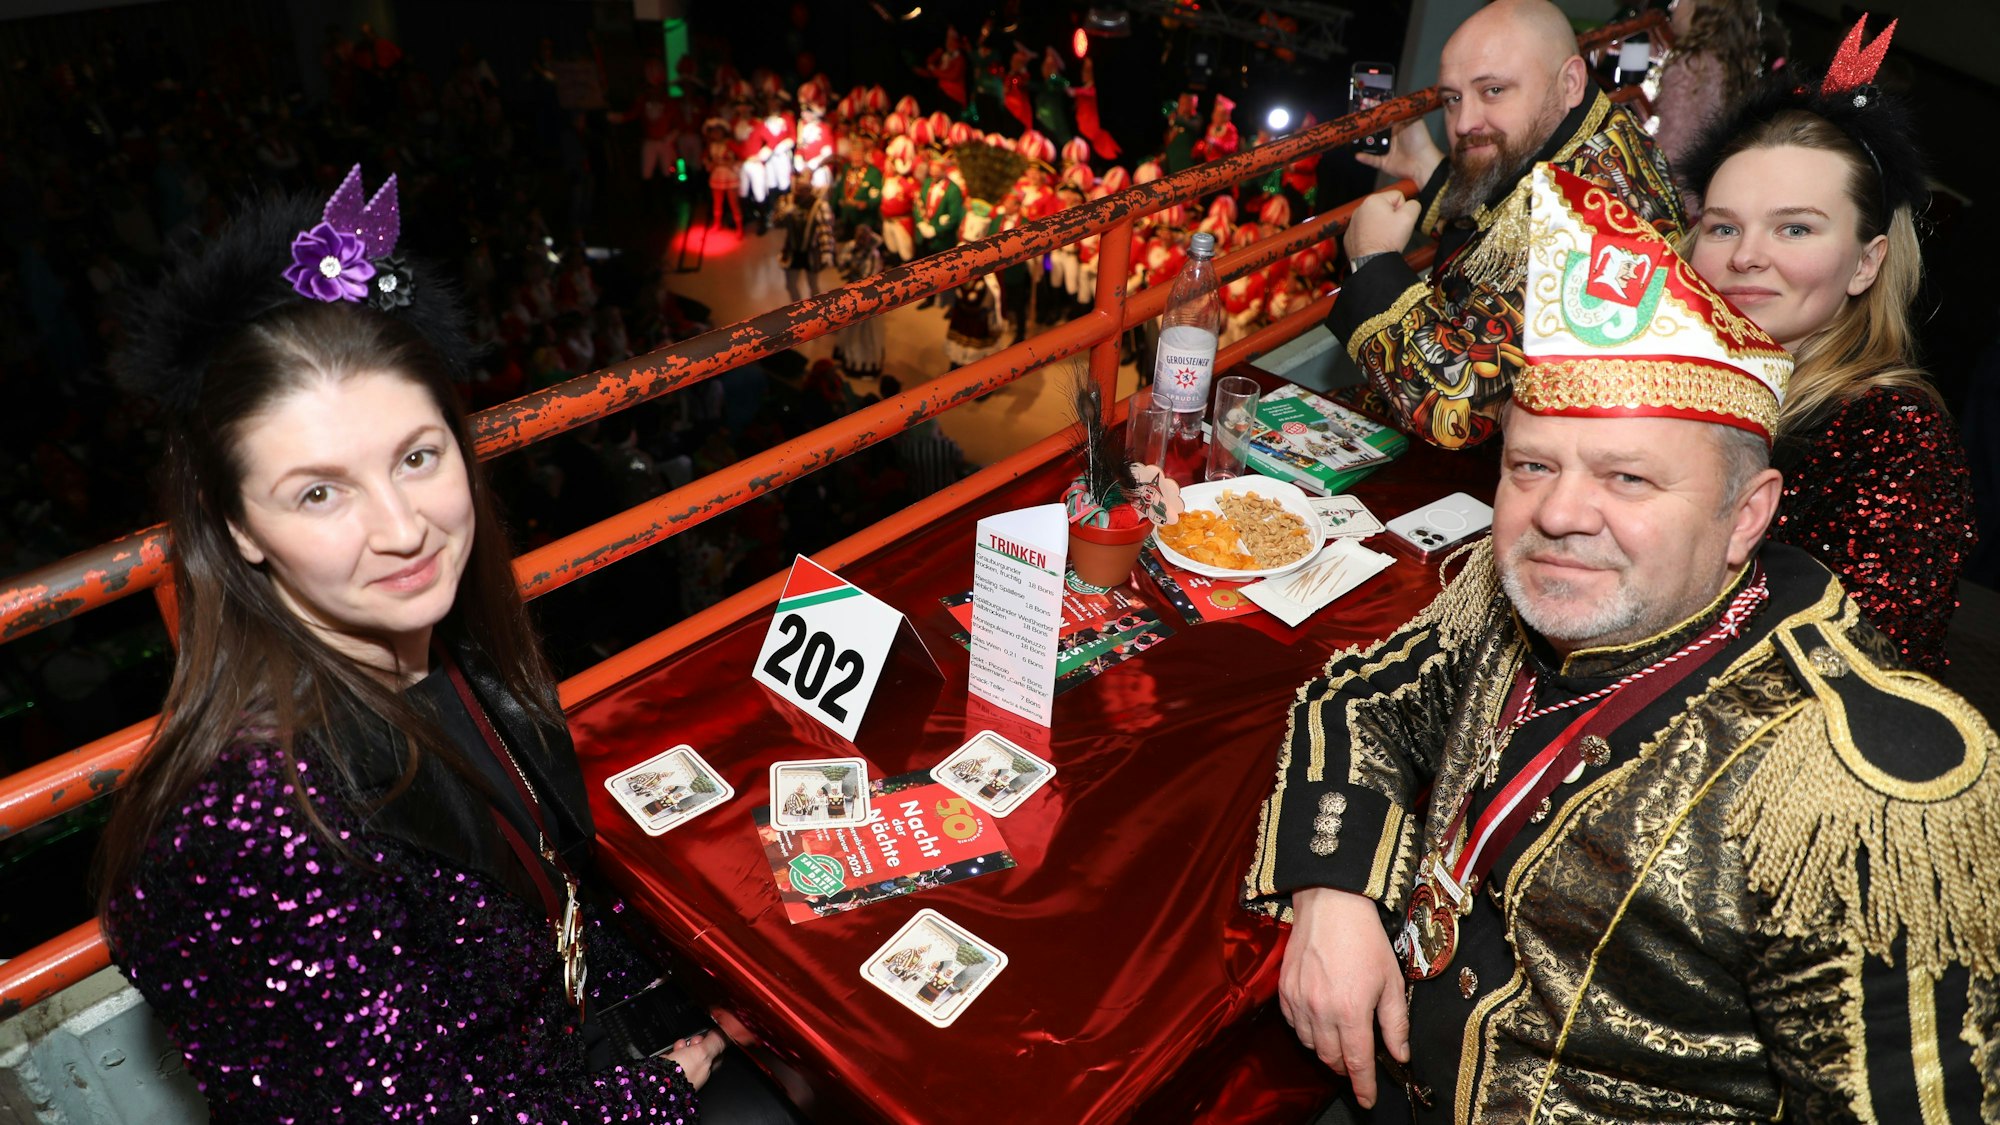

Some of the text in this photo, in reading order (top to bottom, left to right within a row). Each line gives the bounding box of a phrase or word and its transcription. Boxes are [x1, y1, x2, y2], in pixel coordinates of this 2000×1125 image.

[1166, 355, 1210, 367] GEROLSTEINER
[976, 552, 1021, 575] Grauburgunder
[990, 534, 1046, 568] TRINKEN
[976, 574, 998, 589] Riesling
[1000, 570, 1022, 584] fruchtig
[1038, 584, 1054, 596] Bons
[1034, 605, 1051, 617] Bons
[972, 622, 994, 635] trocken
[1030, 646, 1046, 657] Bons
[1032, 626, 1048, 637] Bons
[972, 634, 986, 645] Glas
[986, 641, 1002, 652] Wein
[1028, 659, 1044, 670] Bons
[763, 614, 864, 724] 202
[971, 660, 1006, 679] Geldermann
[972, 654, 984, 663] Sekt
[988, 661, 1010, 674] Piccolo
[1027, 678, 1043, 689] Bons
[970, 673, 1005, 692] Snack-Teller
[1026, 697, 1041, 709] Bons
[870, 808, 900, 868] Nächte
[892, 818, 907, 836] der
[899, 800, 942, 857] Nacht
[835, 828, 864, 877] Februar 2026
[850, 827, 873, 874] nevals-Samstag
[800, 857, 822, 874] SAVE
[820, 872, 837, 886] THE
[808, 872, 830, 890] DATE
